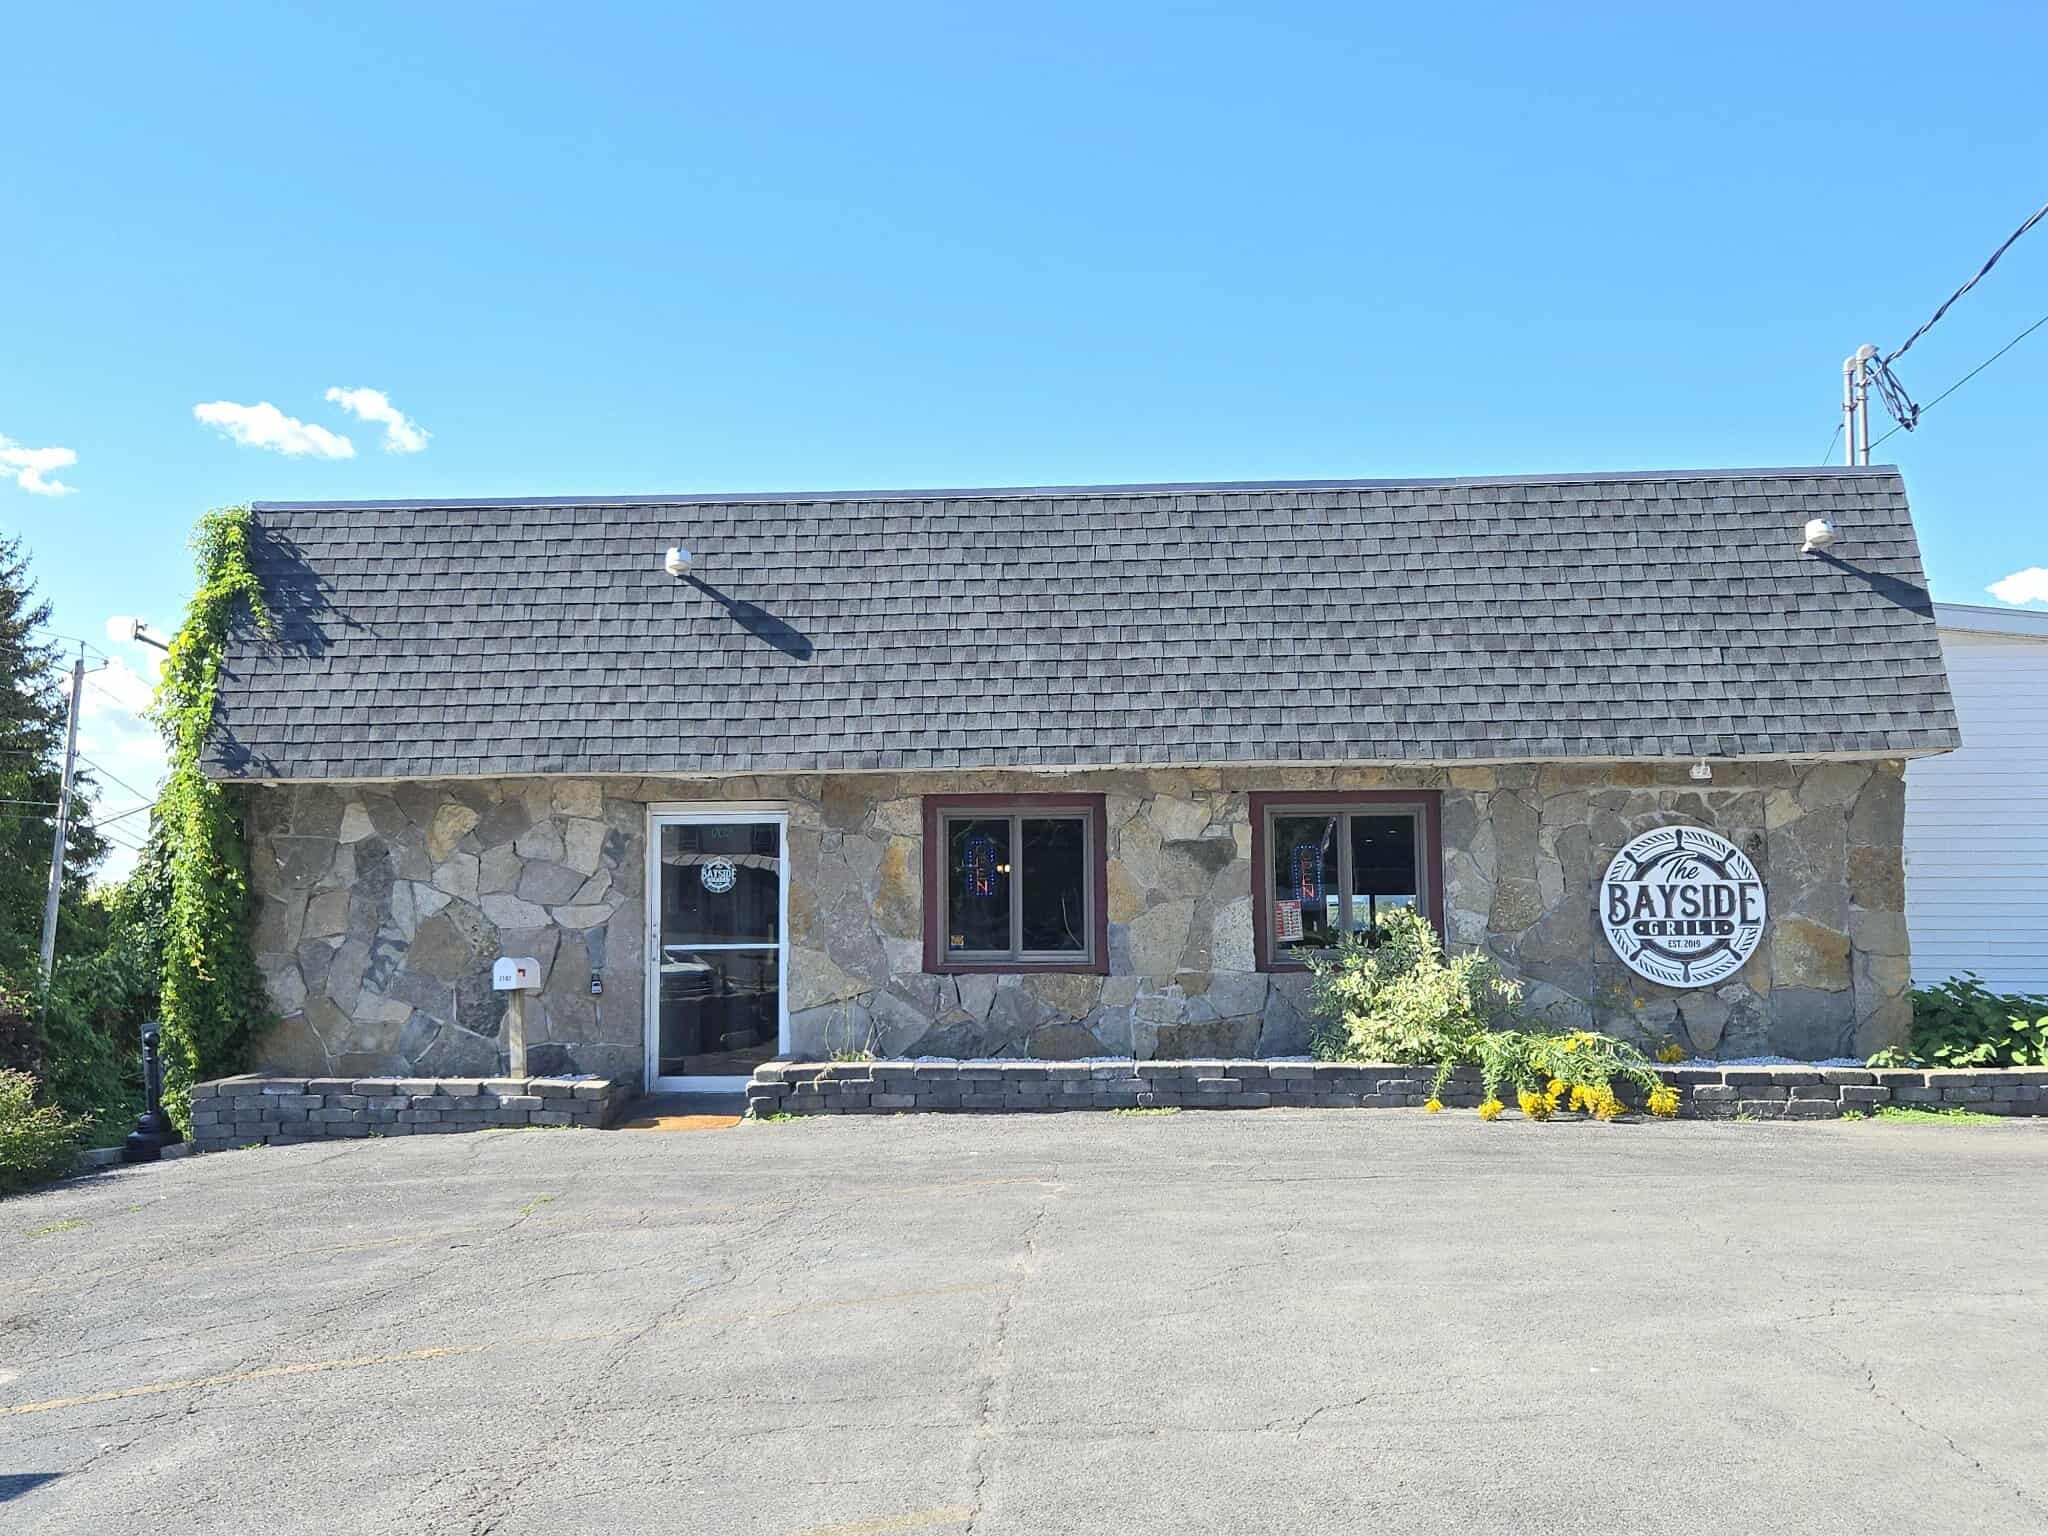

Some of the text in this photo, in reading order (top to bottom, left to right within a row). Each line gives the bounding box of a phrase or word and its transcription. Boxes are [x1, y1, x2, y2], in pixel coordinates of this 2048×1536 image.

[1660, 852, 1699, 883] The
[1607, 883, 1761, 926] BAYSIDE
[1648, 922, 1720, 935] GRILL
[1683, 939, 1701, 948] 2019
